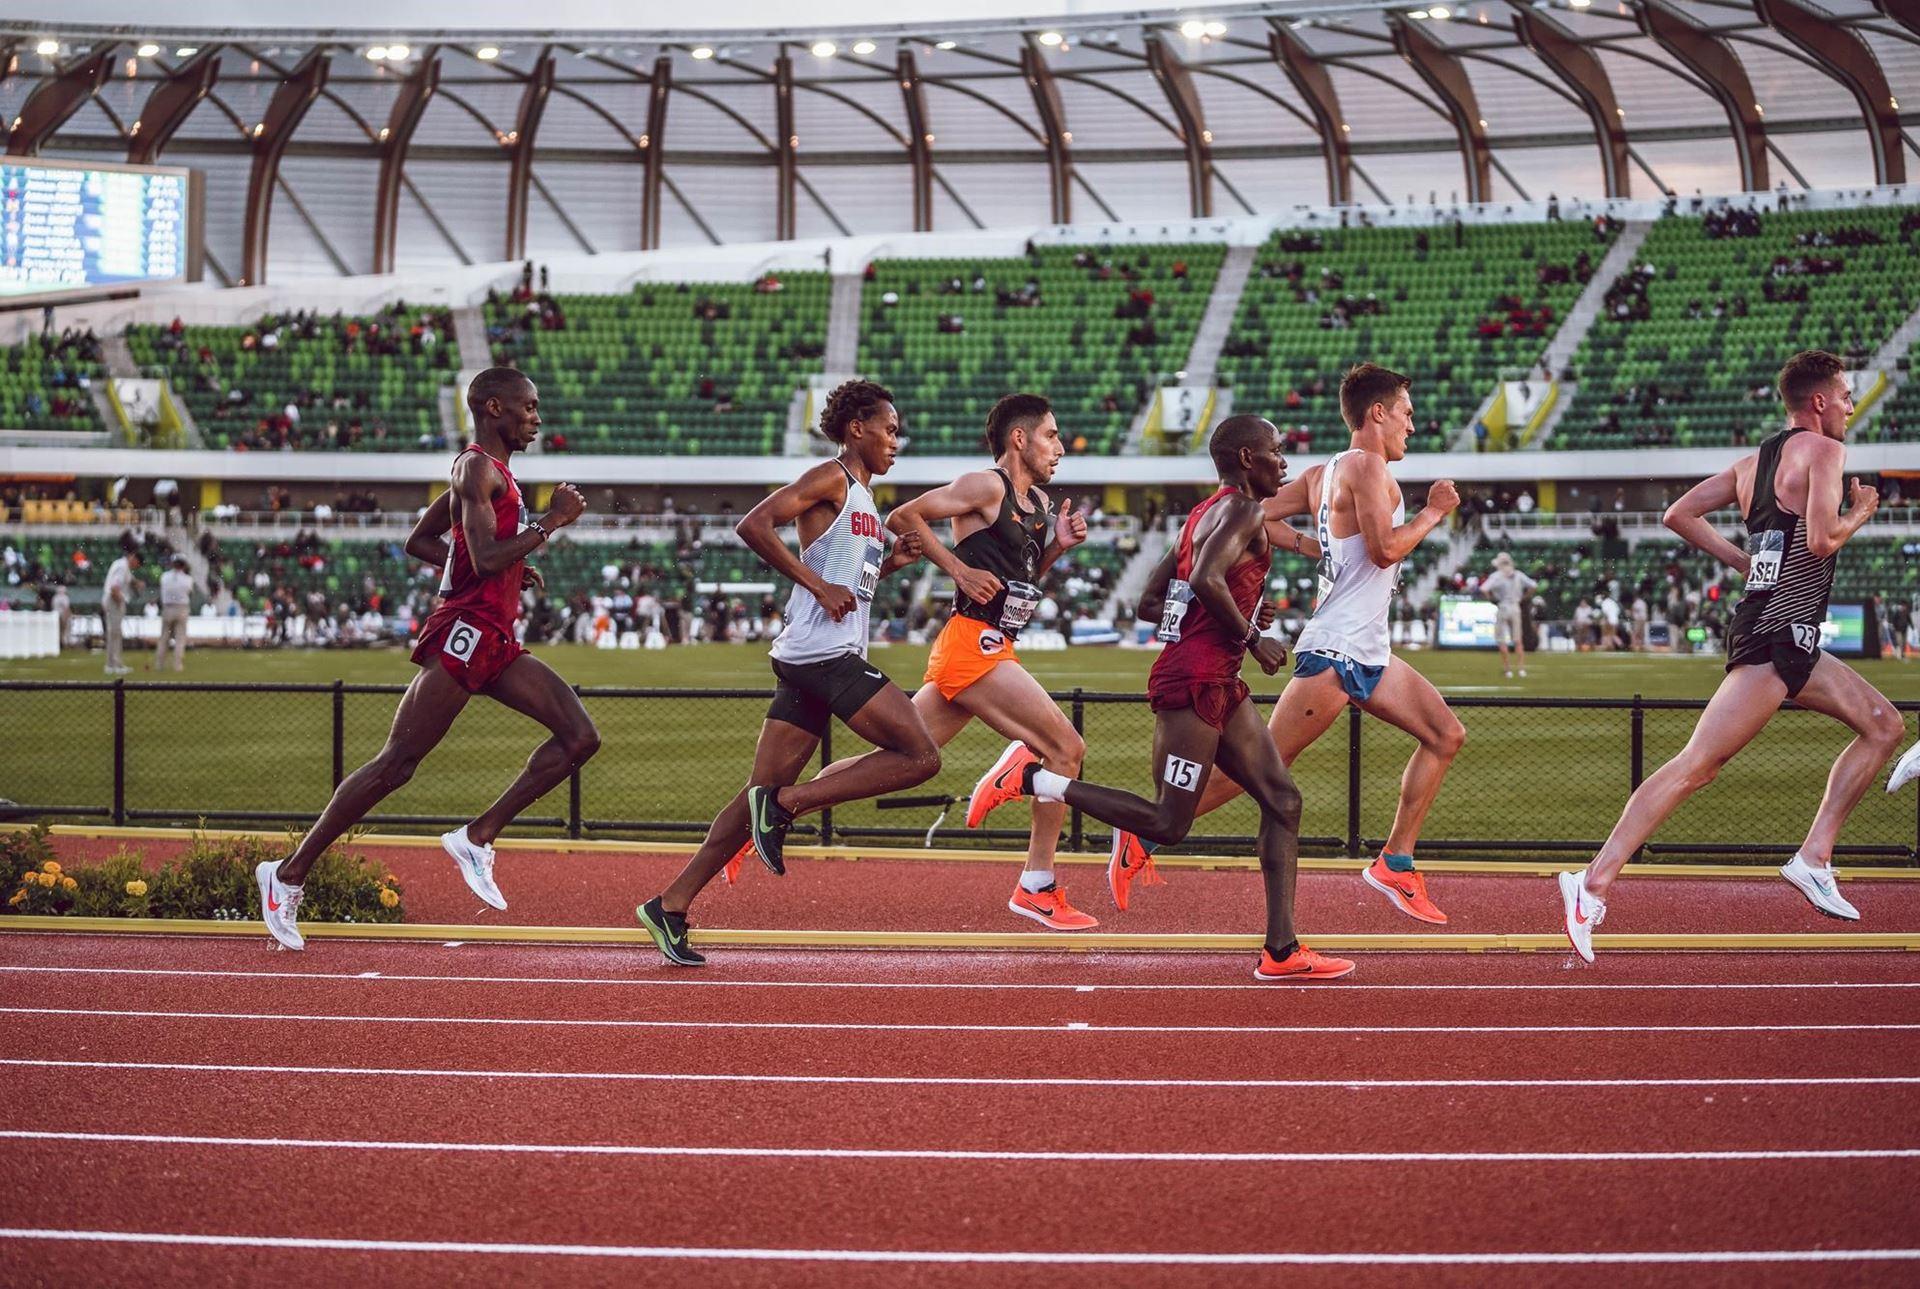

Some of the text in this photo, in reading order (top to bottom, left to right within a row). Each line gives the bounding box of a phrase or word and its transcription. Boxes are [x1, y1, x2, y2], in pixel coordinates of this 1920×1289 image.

[450, 626, 474, 656] 6
[1796, 625, 1815, 650] 23
[1170, 759, 1192, 787] 15
